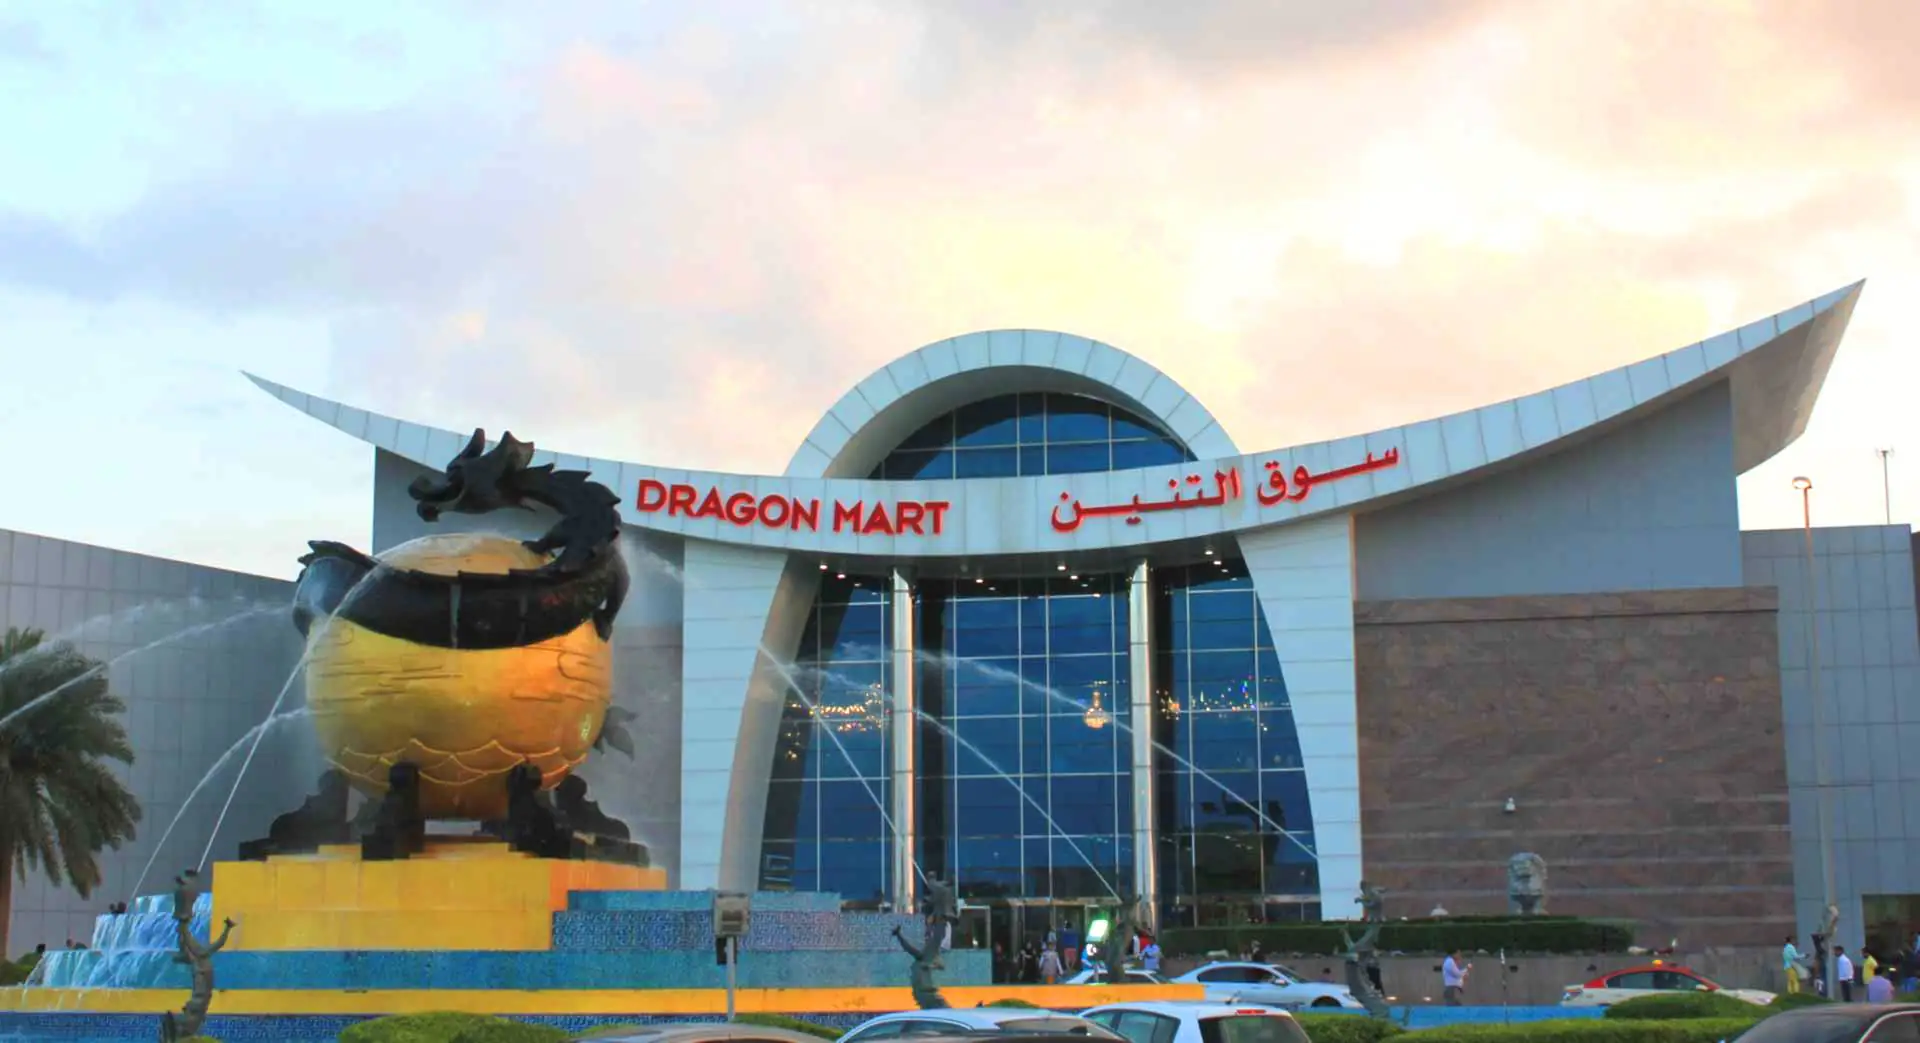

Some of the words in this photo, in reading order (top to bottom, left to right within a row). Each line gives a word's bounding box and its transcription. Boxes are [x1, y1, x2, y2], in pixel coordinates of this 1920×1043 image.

[1051, 467, 1242, 533] التنين
[1256, 445, 1399, 507] سوق
[636, 479, 821, 532] DRAGON
[832, 500, 950, 536] MART
